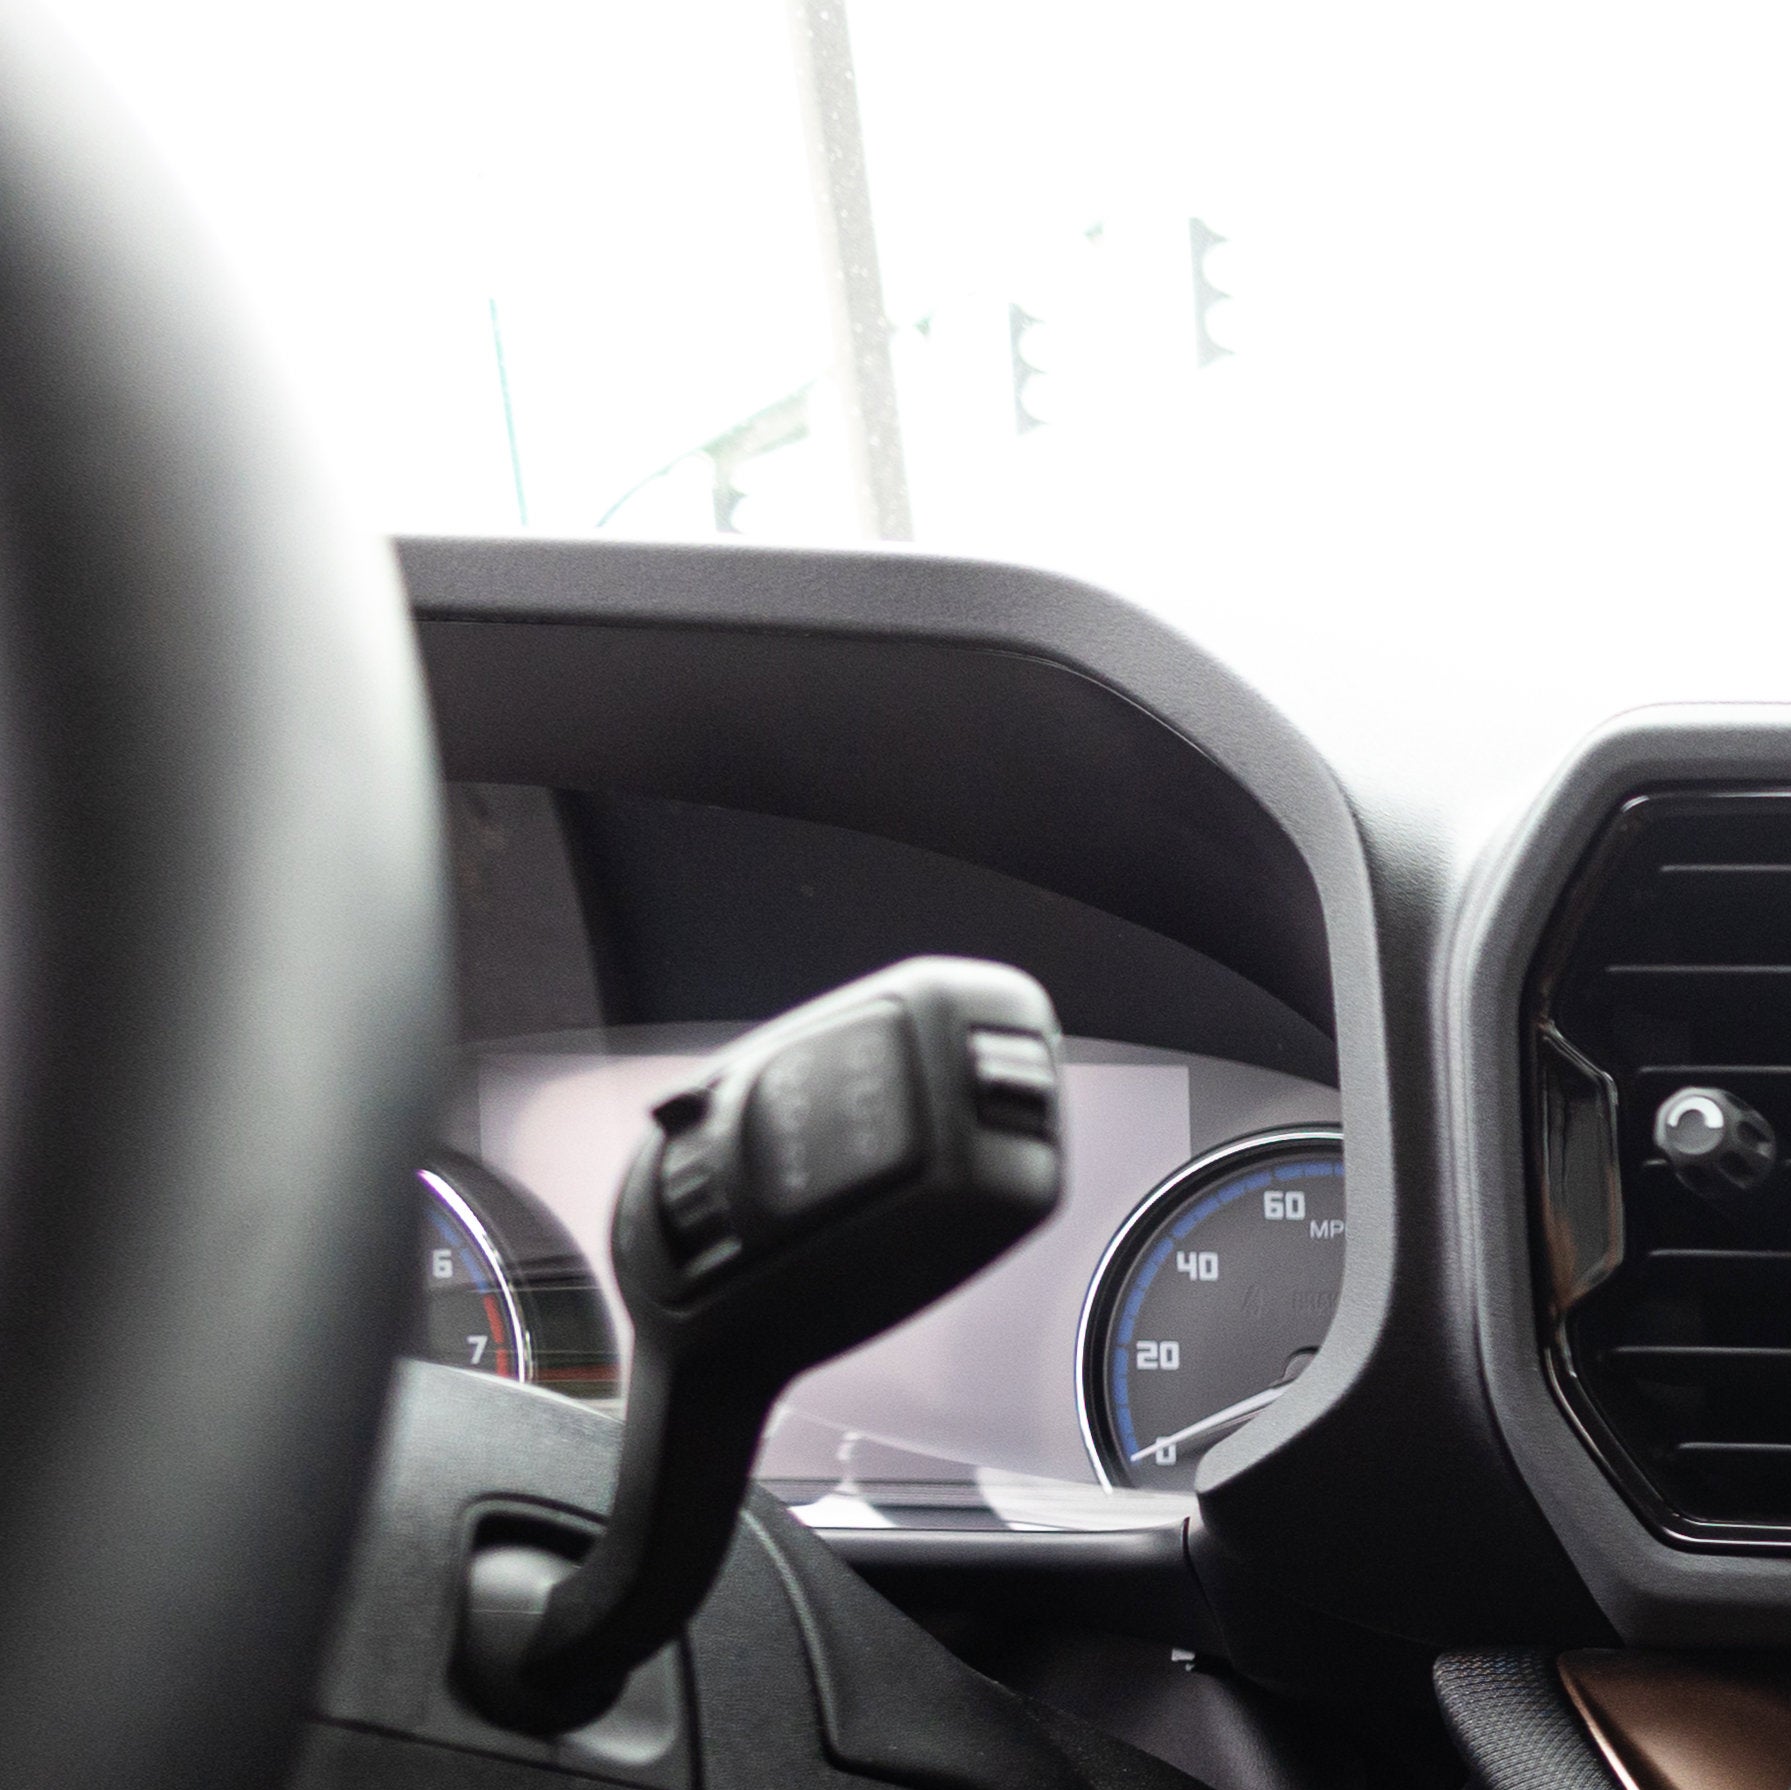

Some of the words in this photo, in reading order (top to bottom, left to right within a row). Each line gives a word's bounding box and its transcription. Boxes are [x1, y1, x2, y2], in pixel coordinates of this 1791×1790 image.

[1264, 1191, 1305, 1220] 60
[1310, 1220, 1345, 1238] MP
[433, 1249, 453, 1278] 6
[1177, 1251, 1219, 1281] 40
[467, 1336, 488, 1364] 7
[1136, 1341, 1180, 1370] 20
[1155, 1437, 1177, 1466] 0
